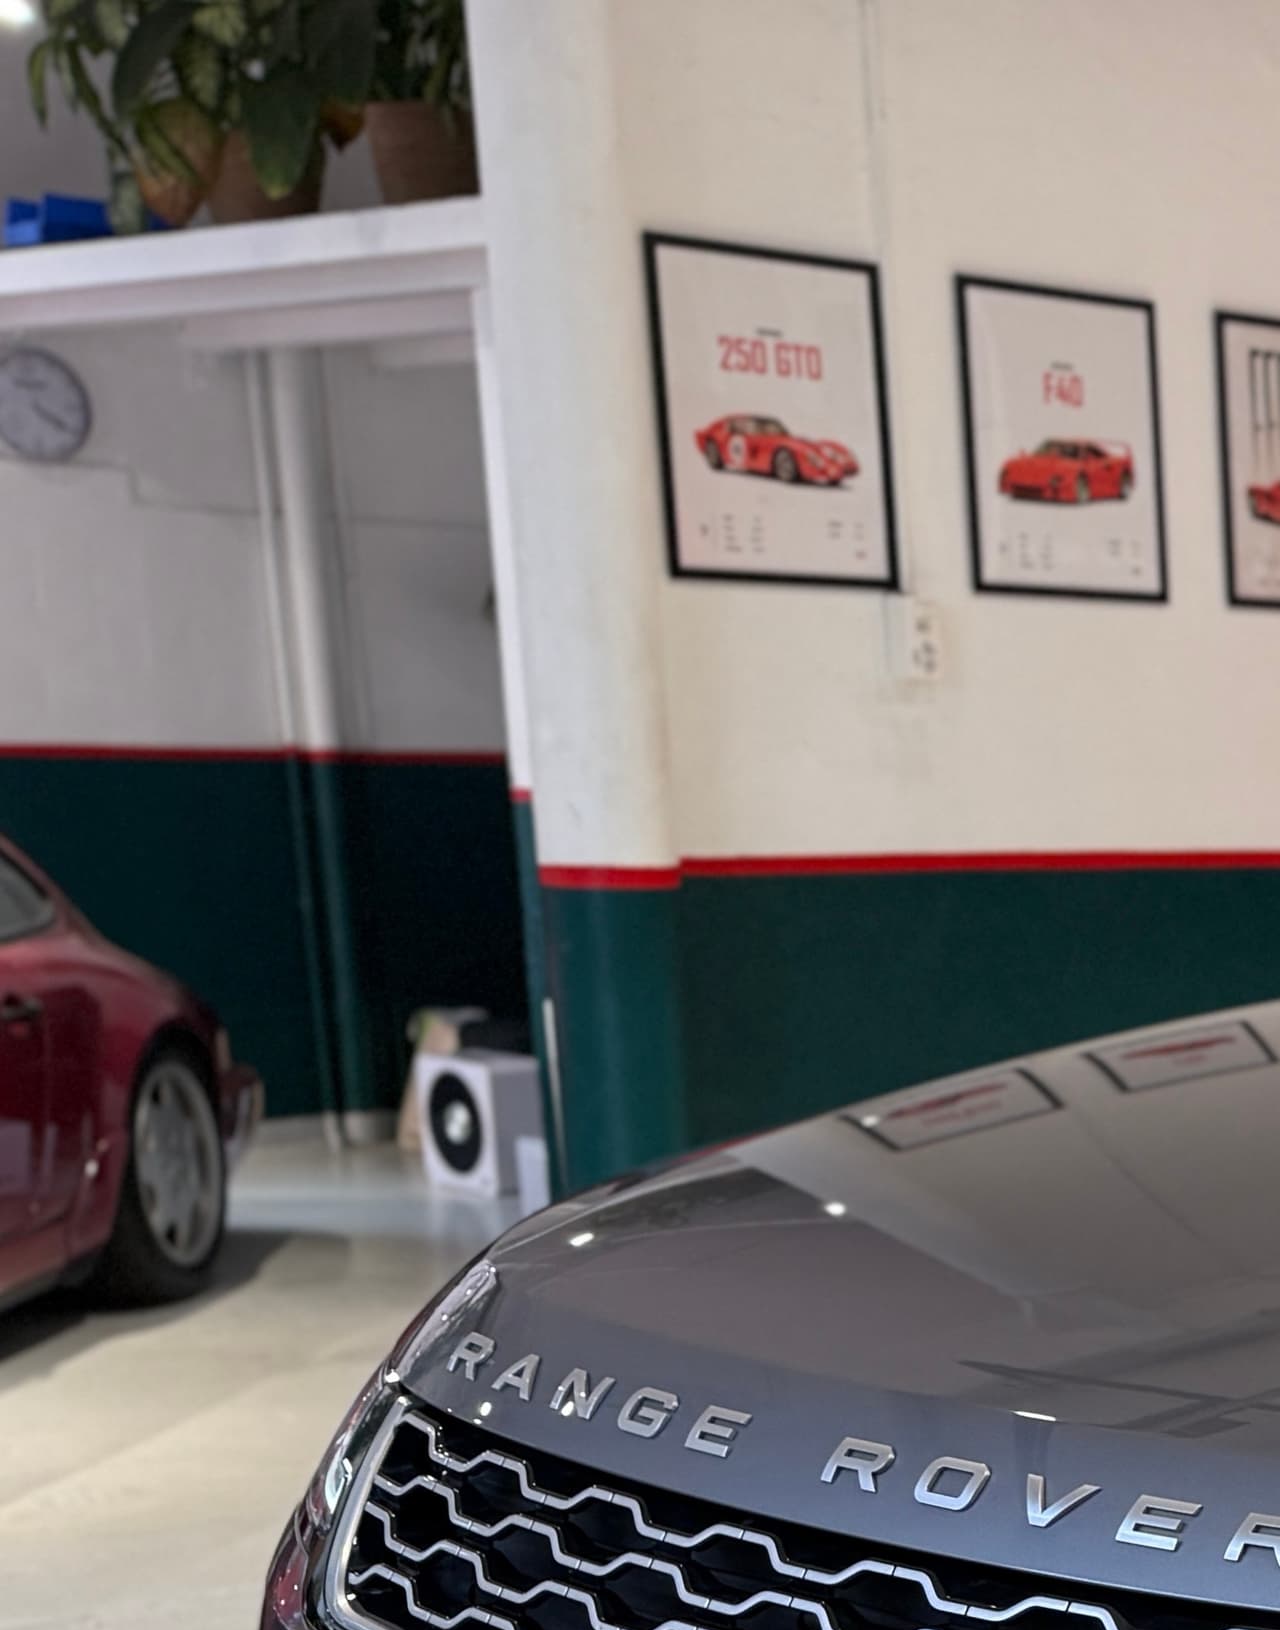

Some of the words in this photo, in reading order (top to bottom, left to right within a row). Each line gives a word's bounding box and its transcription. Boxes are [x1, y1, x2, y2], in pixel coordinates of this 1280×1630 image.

[717, 334, 767, 375] 250
[774, 340, 823, 381] GTO
[1043, 371, 1083, 408] F40
[447, 1331, 753, 1459] RANGE
